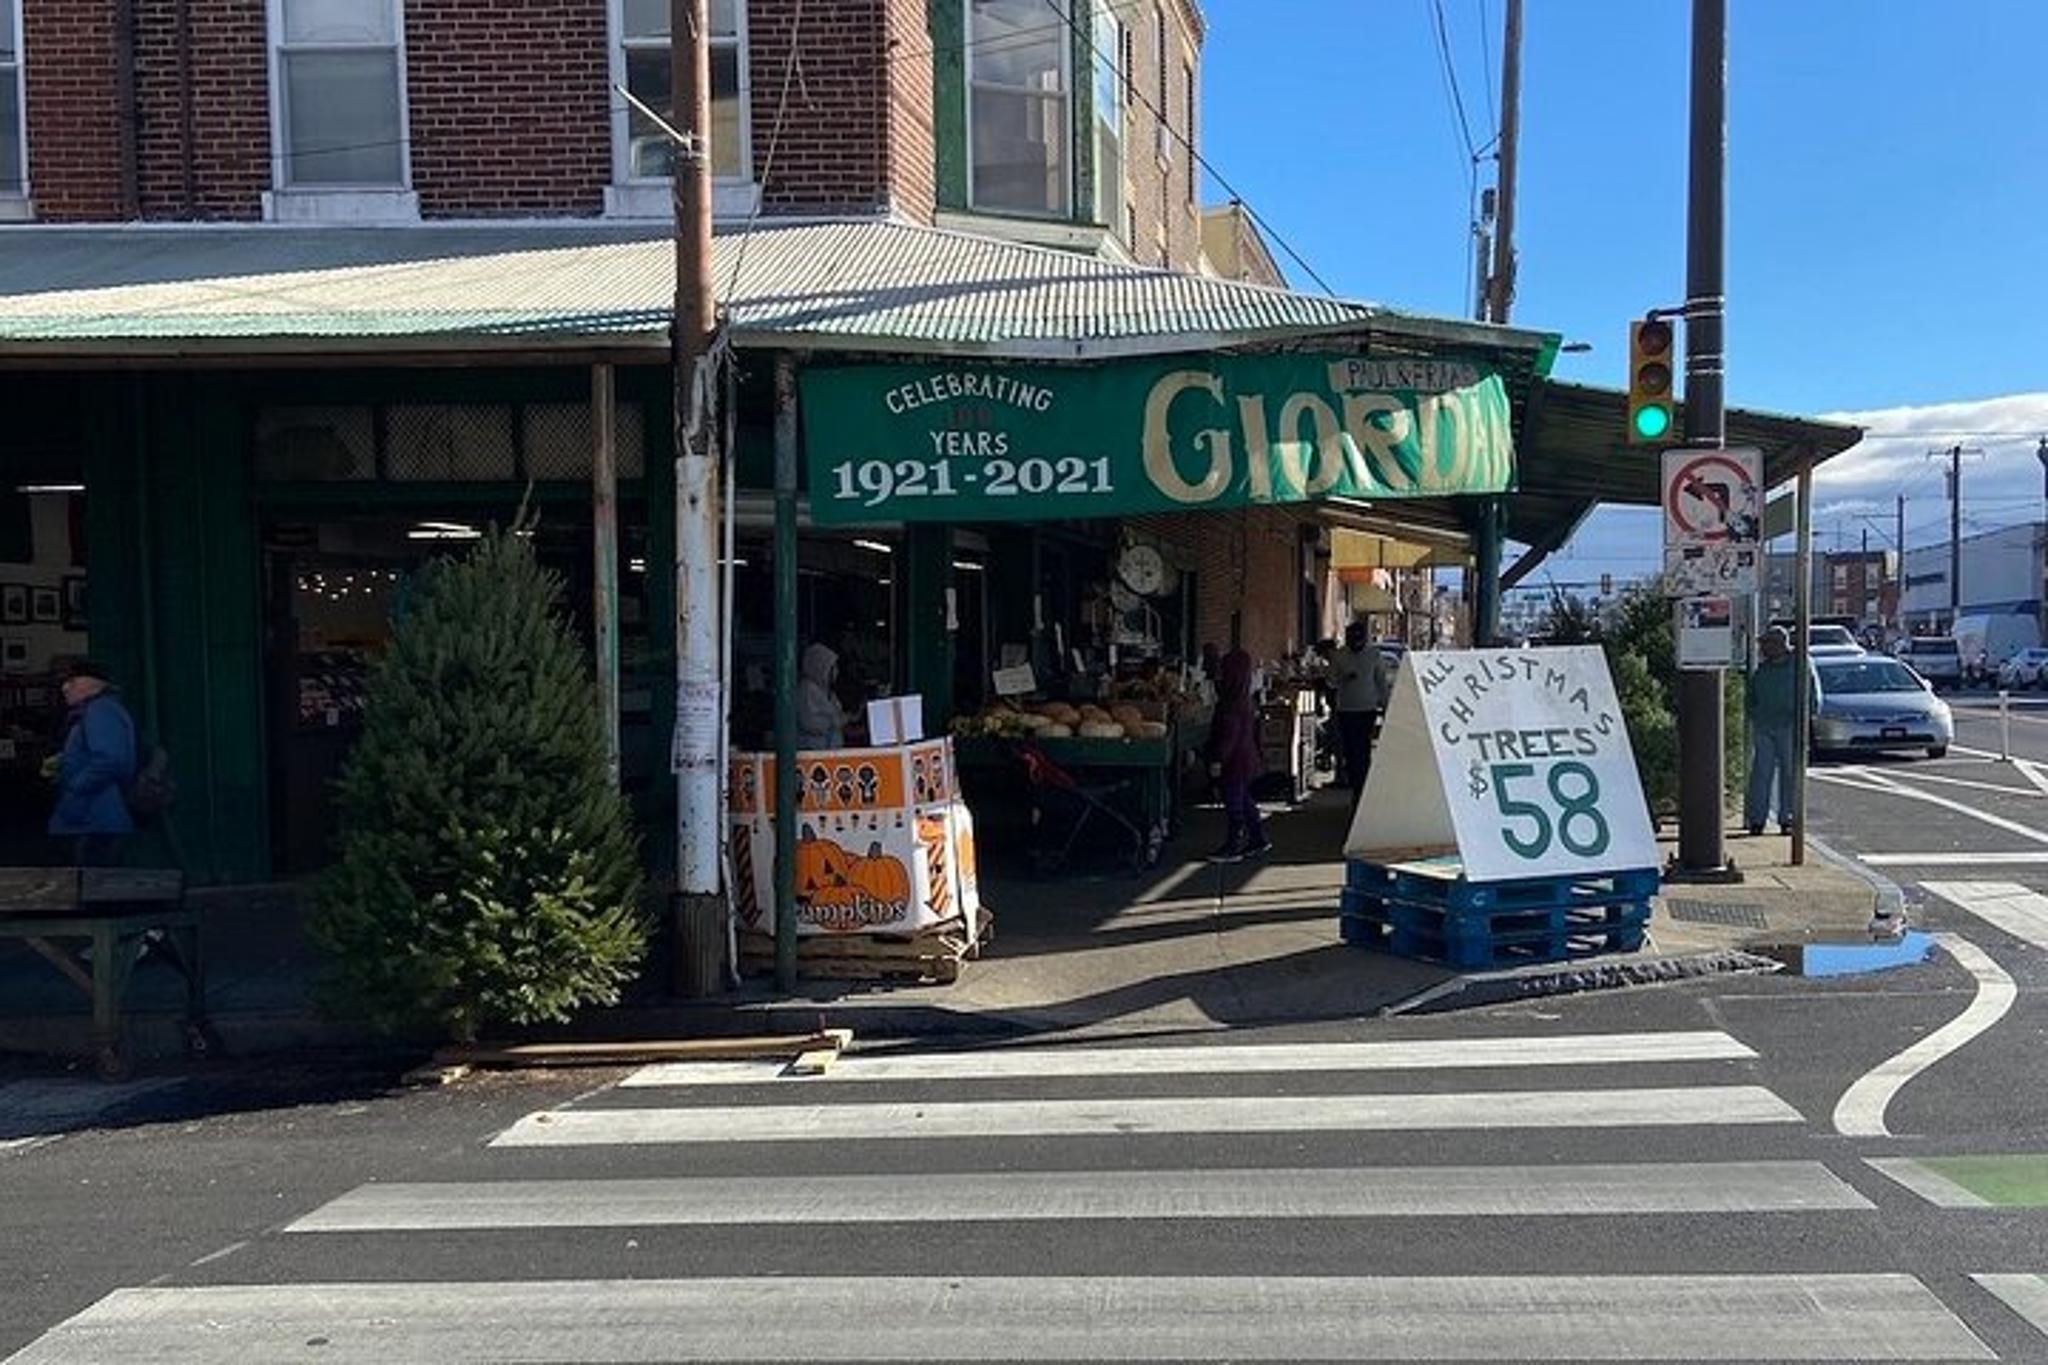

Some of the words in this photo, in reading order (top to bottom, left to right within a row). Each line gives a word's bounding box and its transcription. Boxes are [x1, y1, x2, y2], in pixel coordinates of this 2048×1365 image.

[886, 373, 1053, 414] CELEBRATING
[930, 431, 1008, 456] YEARS
[832, 456, 1115, 507] 1921-2021
[1420, 659, 1455, 694] ALL
[1441, 656, 1614, 746] CHRISTMAS
[1467, 728, 1598, 761] TREES
[796, 894, 907, 928] umpkins
